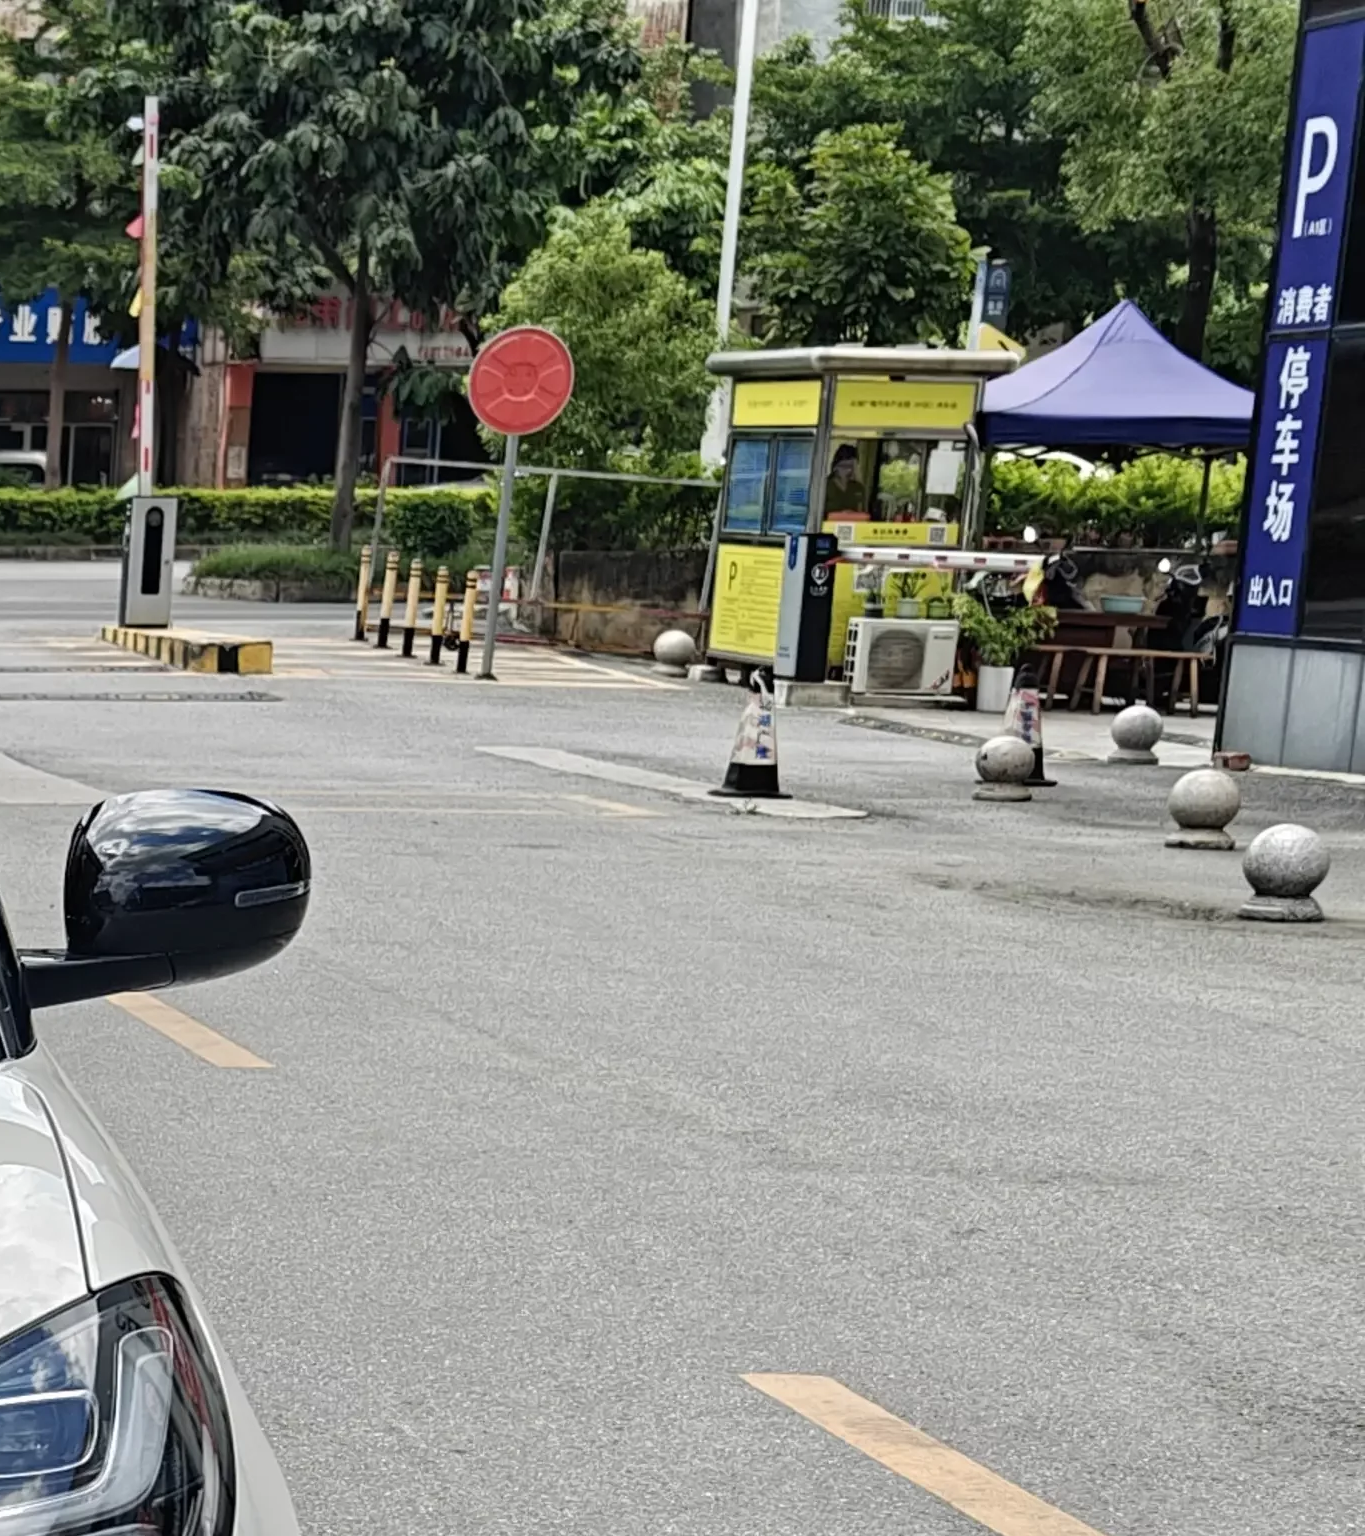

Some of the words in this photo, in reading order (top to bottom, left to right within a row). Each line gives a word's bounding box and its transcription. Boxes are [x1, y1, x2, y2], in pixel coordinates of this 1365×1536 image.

[1291, 115, 1339, 239] P
[1276, 283, 1333, 325] 消费者
[1262, 344, 1312, 543] 停车场
[1247, 573, 1293, 608] 出入口
